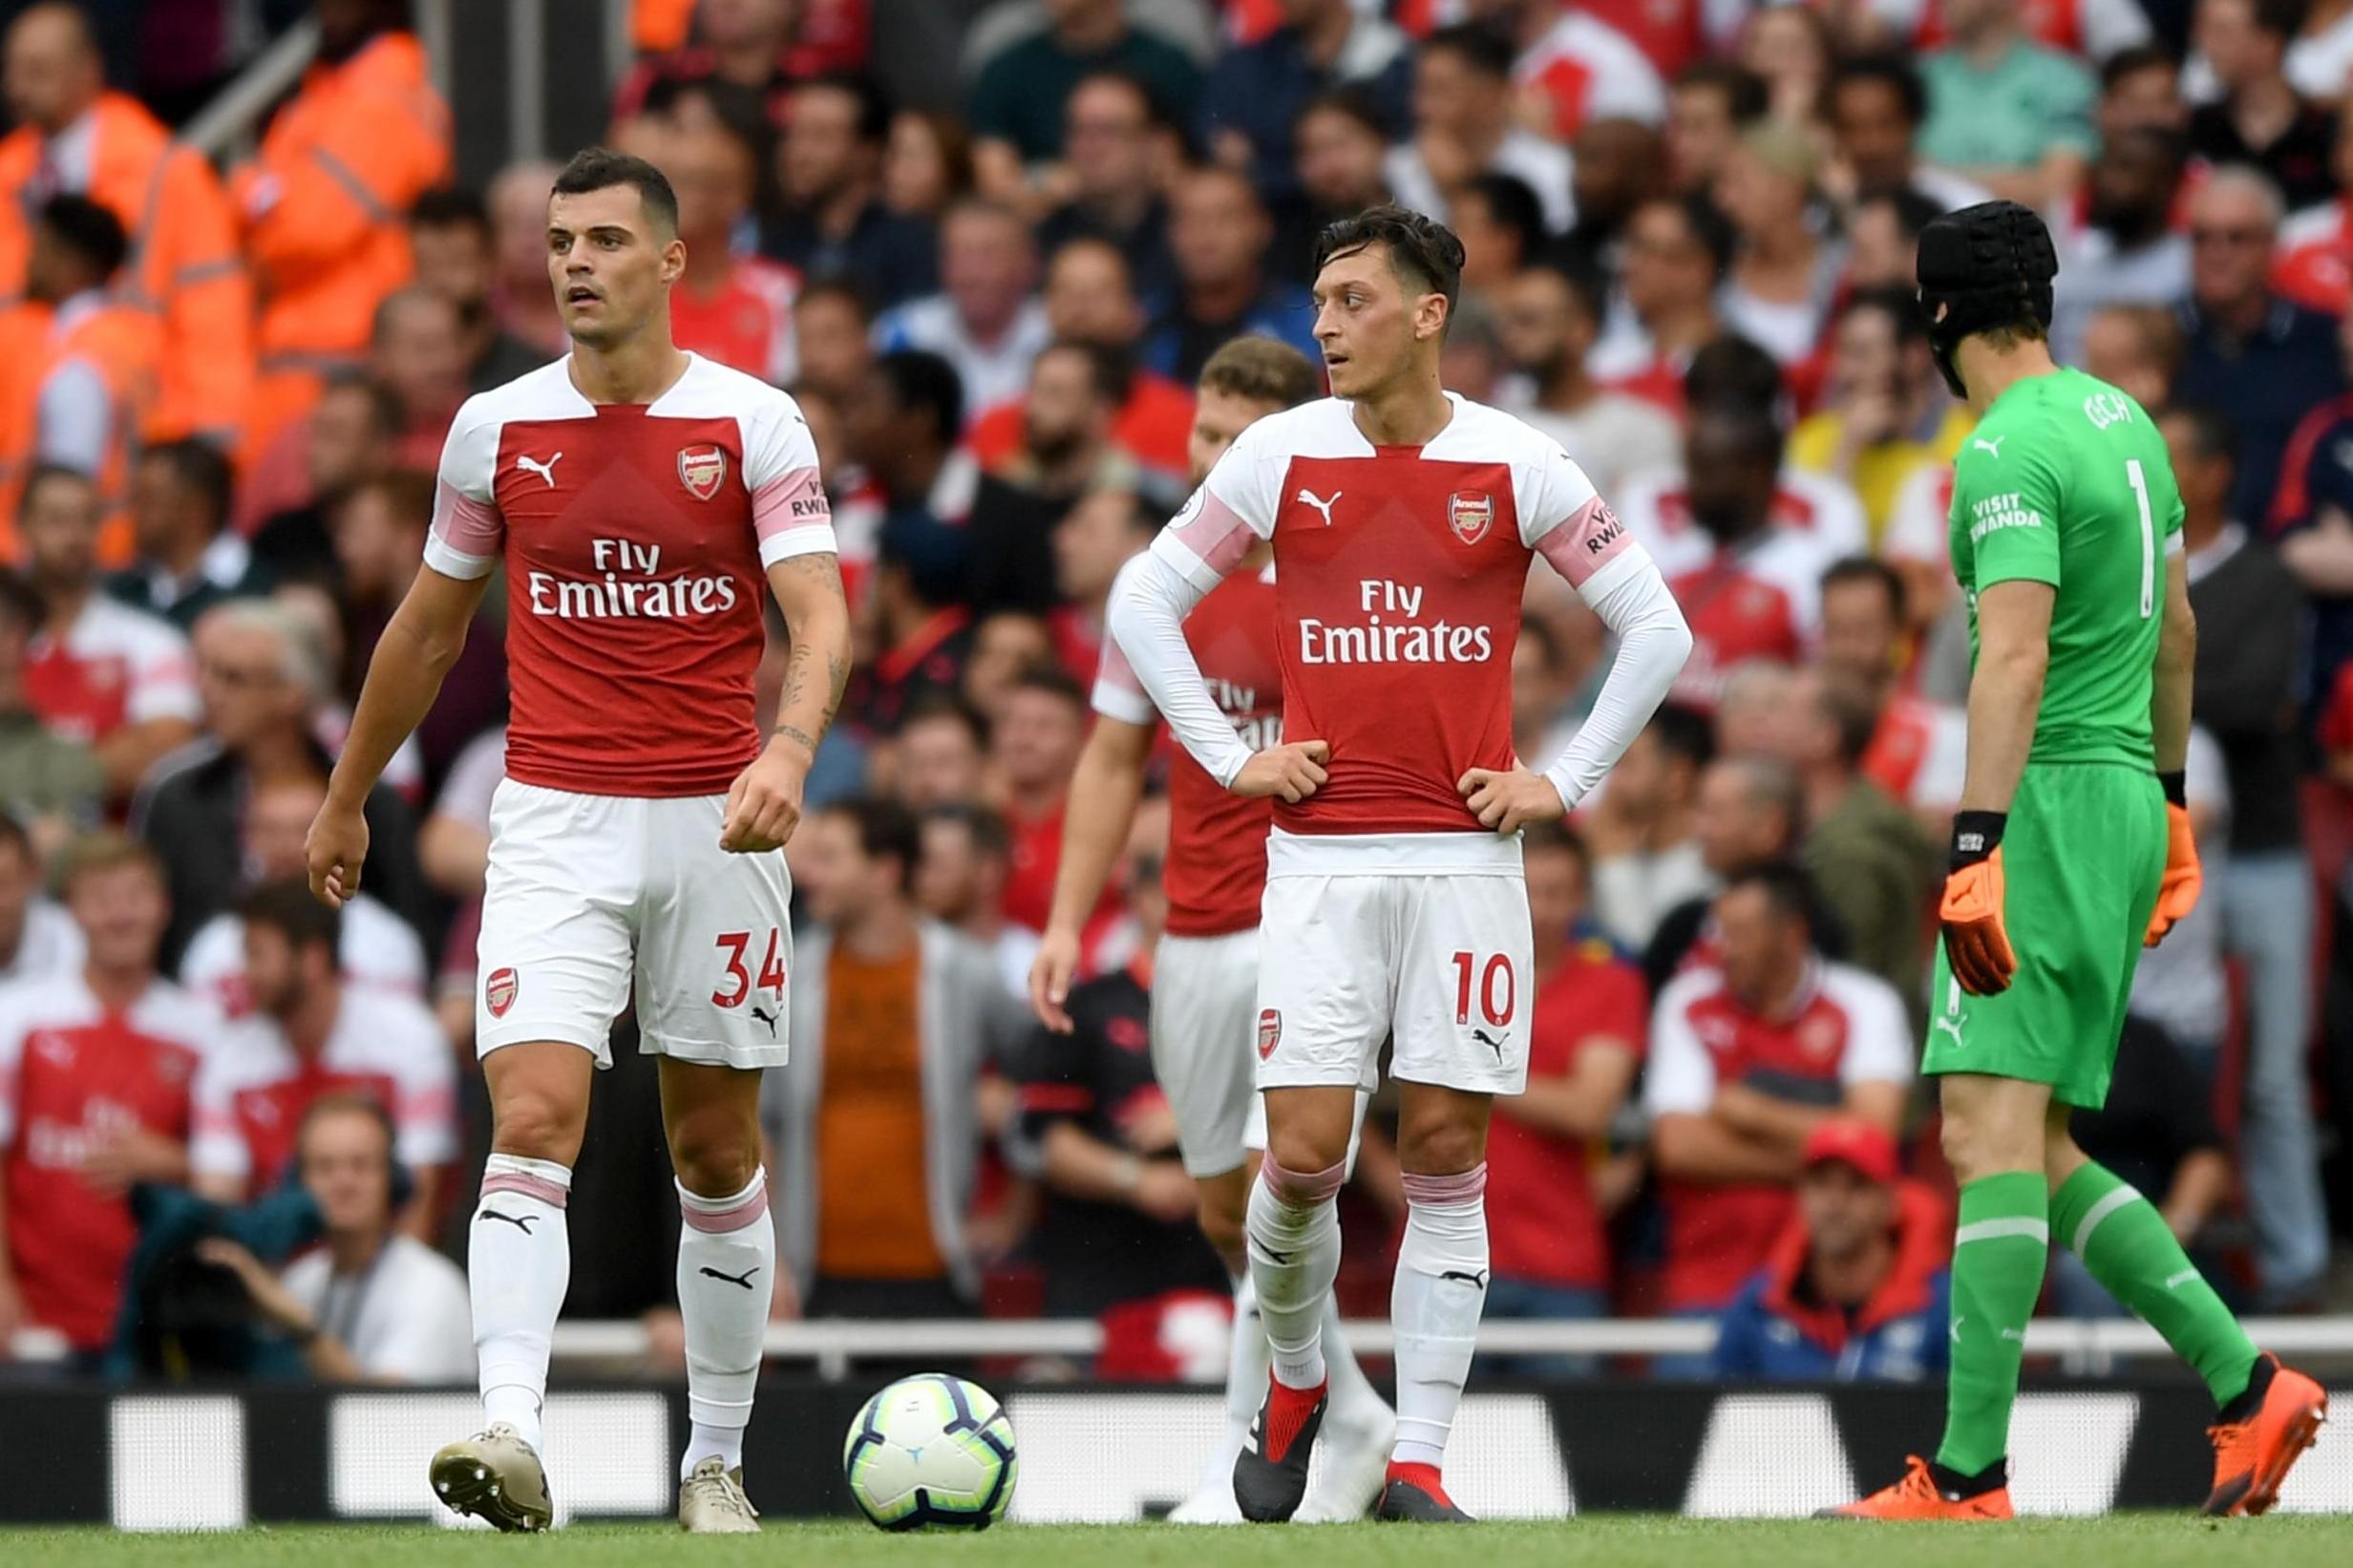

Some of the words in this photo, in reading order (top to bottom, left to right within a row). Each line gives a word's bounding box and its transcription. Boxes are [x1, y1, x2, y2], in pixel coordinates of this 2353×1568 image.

[1969, 509, 2044, 545] WANDA
[1972, 491, 2022, 519] VISIT
[592, 539, 661, 576] Fly
[2126, 458, 2155, 619] 1
[528, 571, 736, 619] Emirates
[1360, 579, 1424, 618] Fly
[1299, 614, 1492, 664] Emirates
[710, 926, 786, 1009] 34
[1451, 950, 1516, 1028] 10
